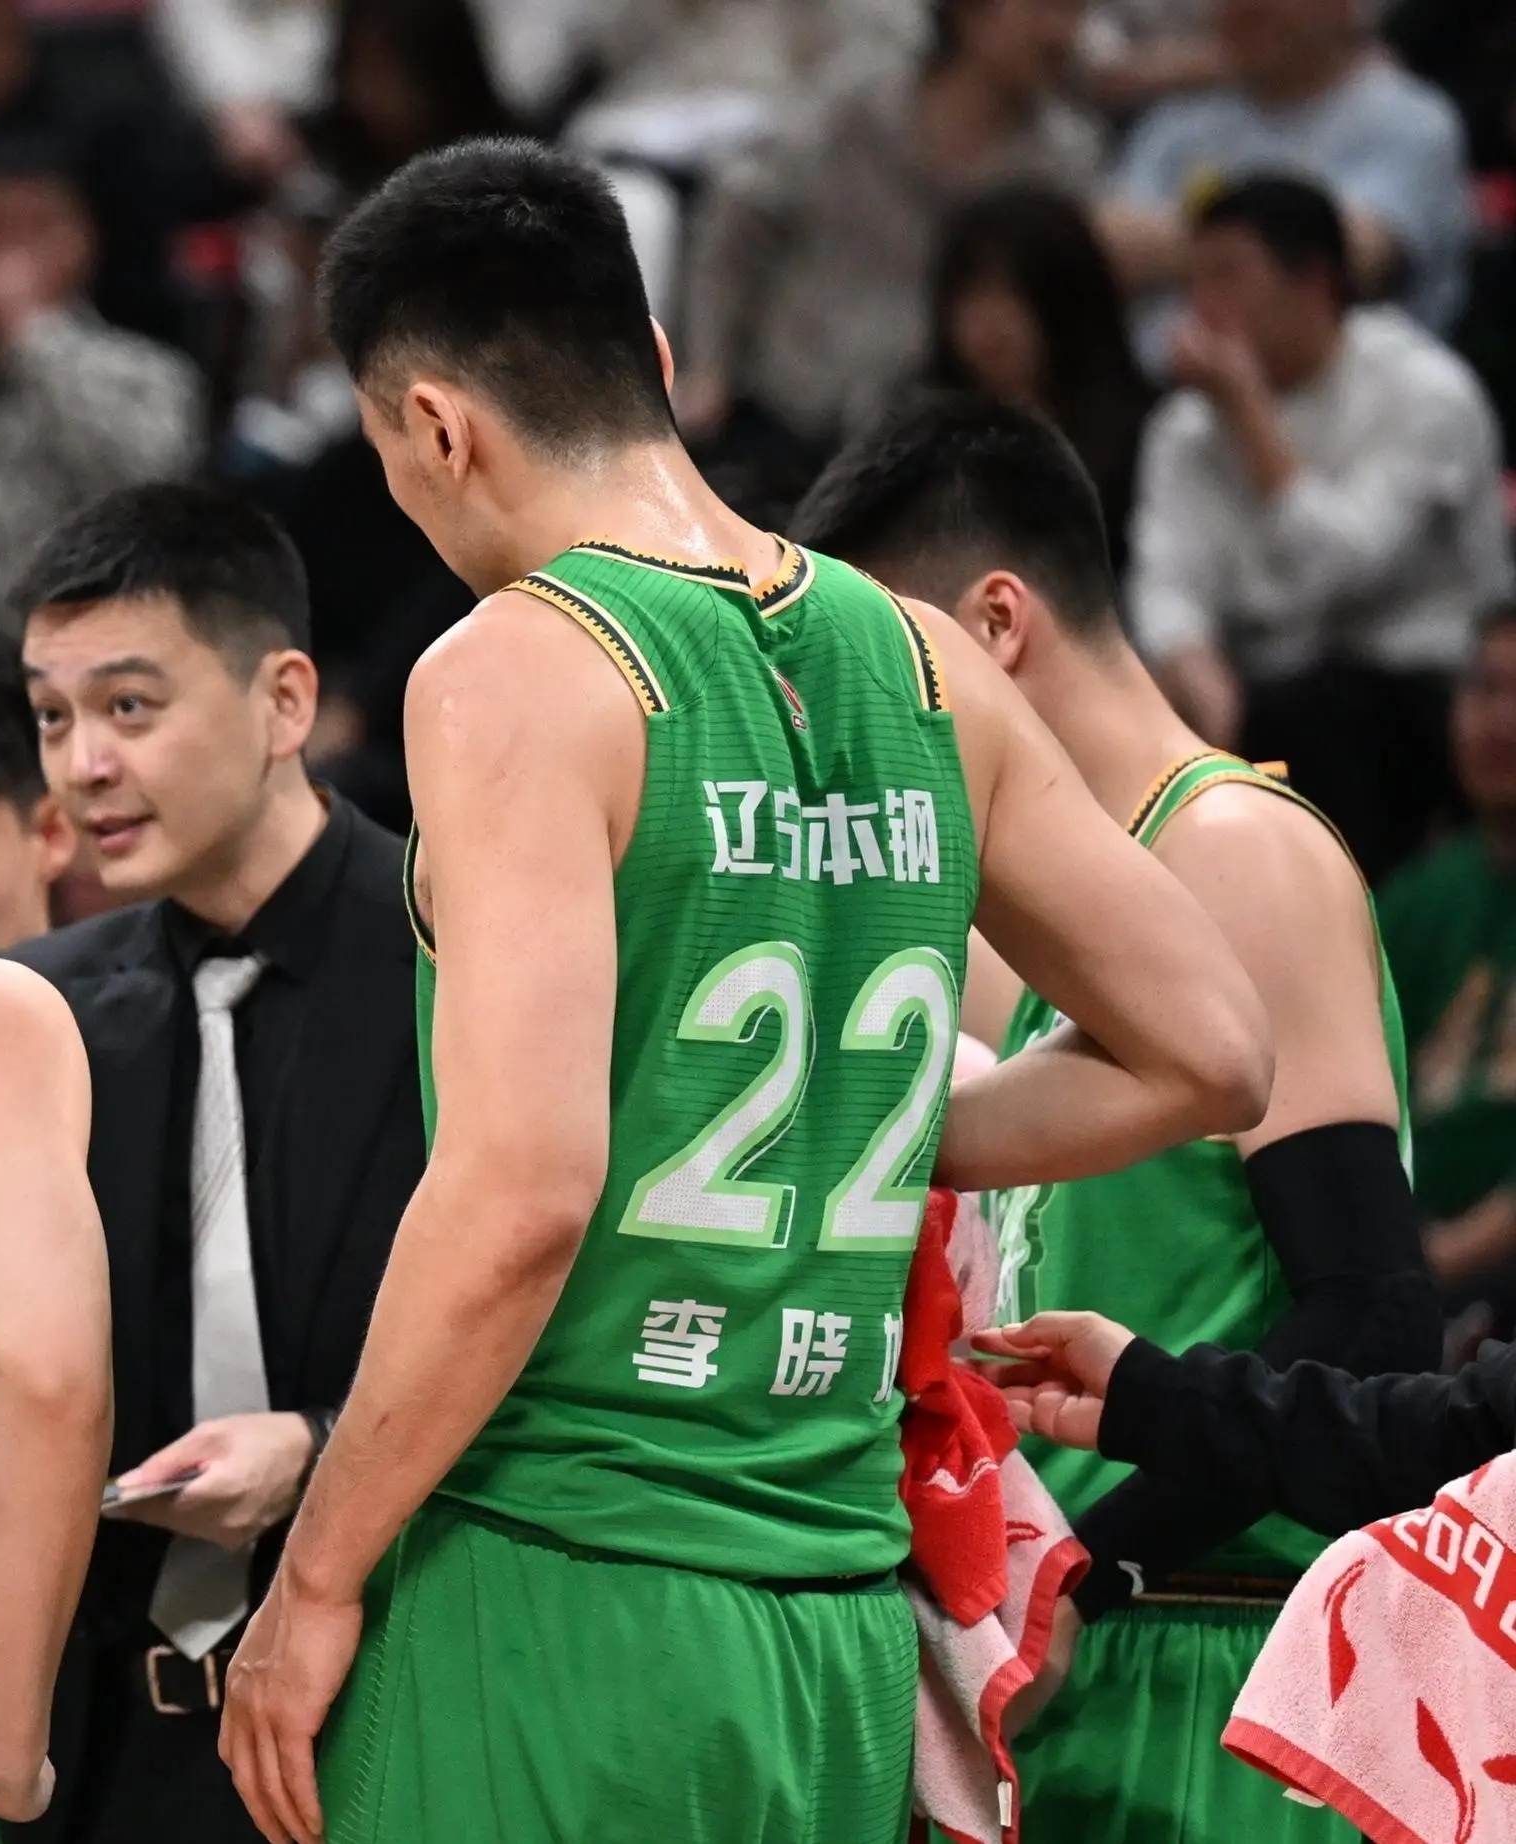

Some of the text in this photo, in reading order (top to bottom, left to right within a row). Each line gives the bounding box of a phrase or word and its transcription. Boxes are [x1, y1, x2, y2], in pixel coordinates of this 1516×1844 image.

[702, 780, 940, 885] 辽宁本钢
[617, 940, 959, 1252] 22
